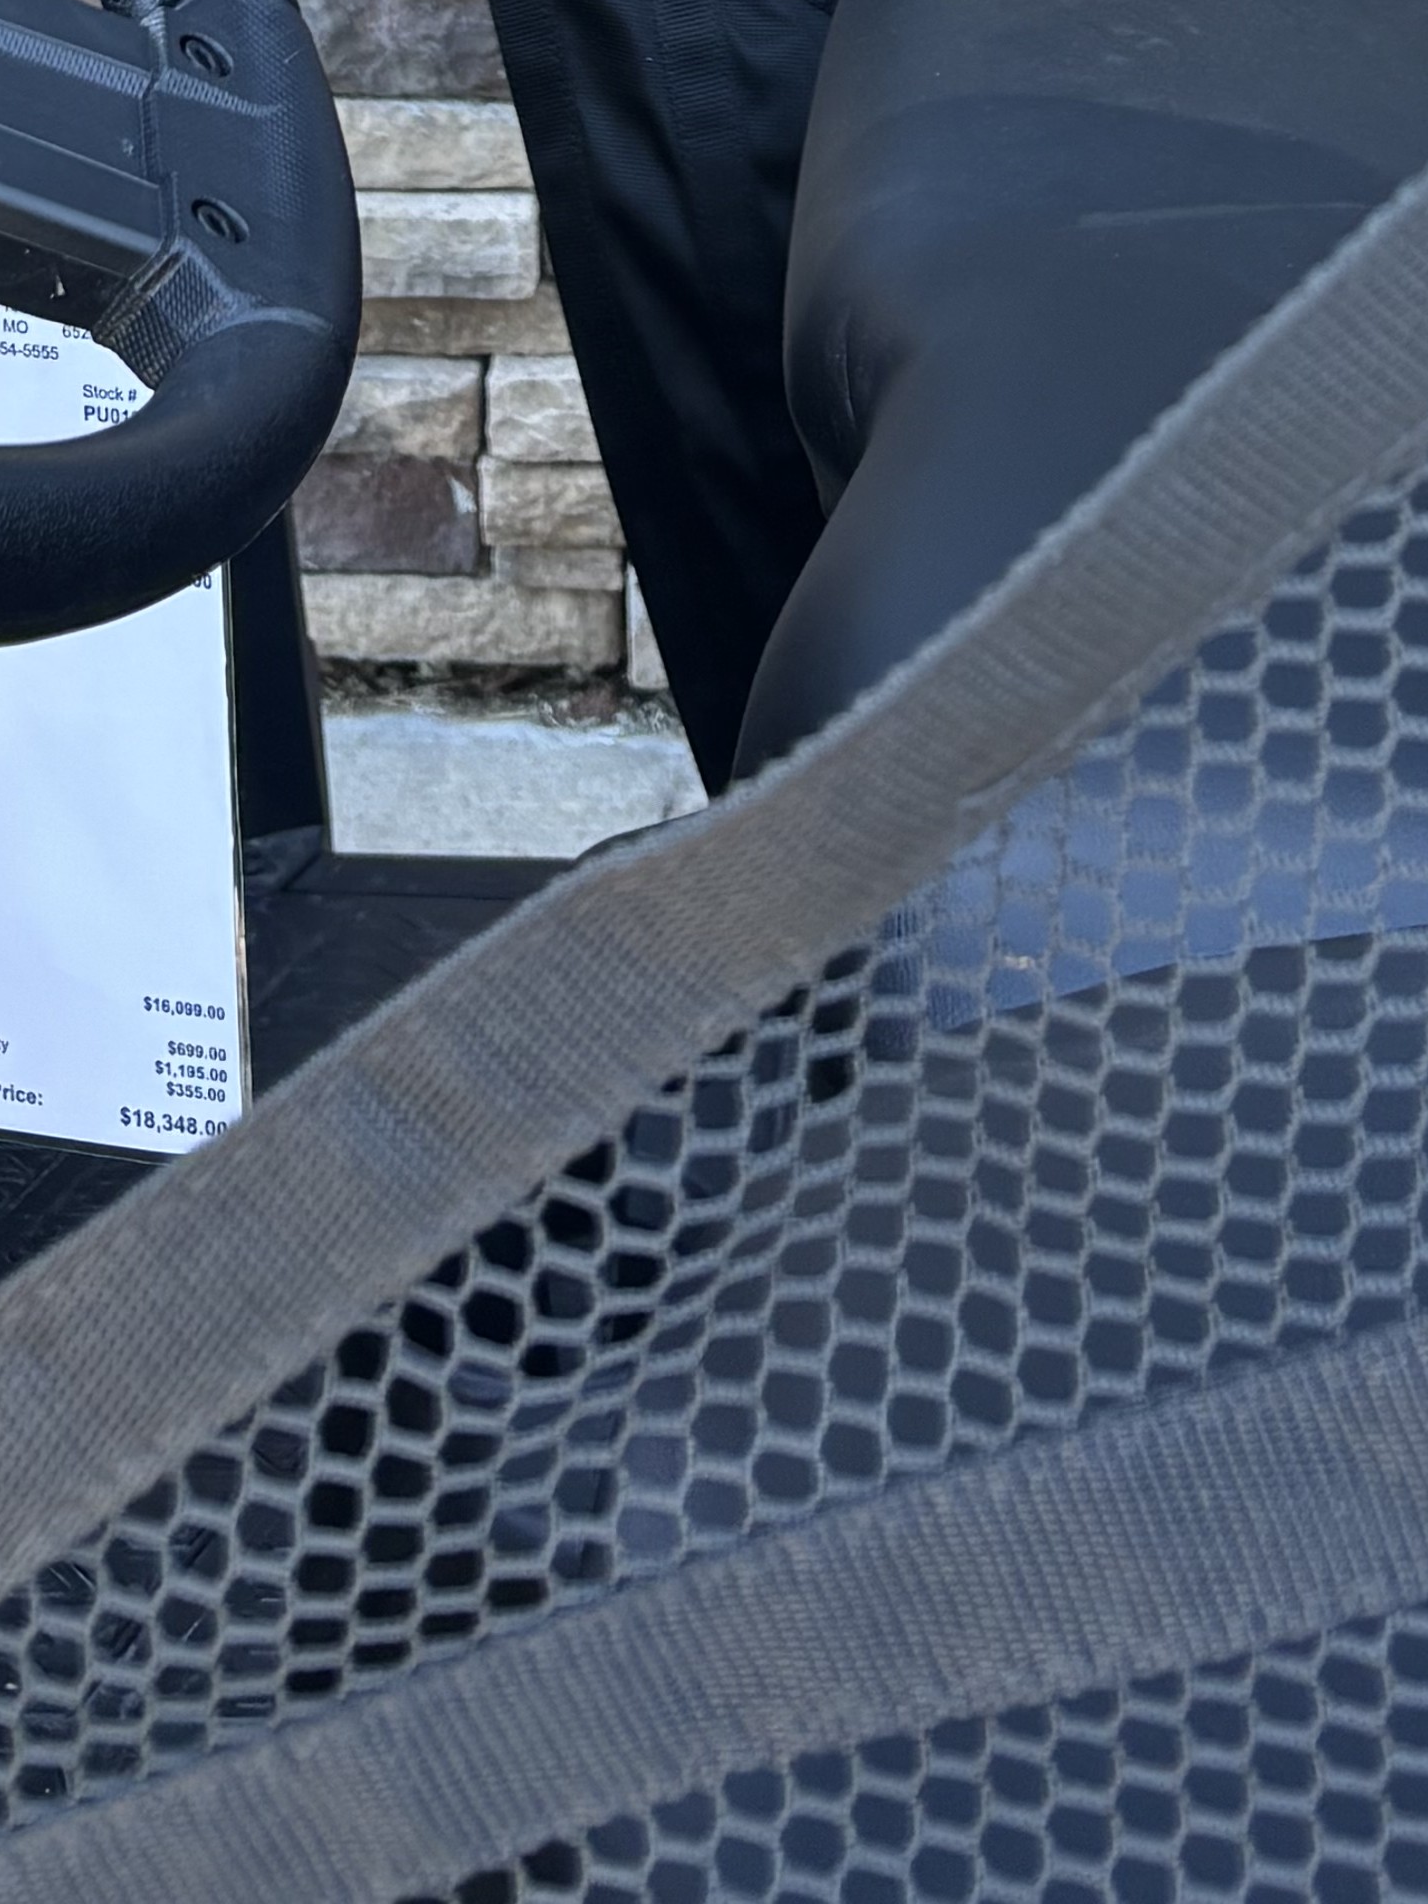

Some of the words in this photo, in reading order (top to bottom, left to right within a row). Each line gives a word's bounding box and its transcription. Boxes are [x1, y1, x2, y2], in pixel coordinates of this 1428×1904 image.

[3, 318, 29, 335] MO
[82, 384, 124, 402] Stock
[142, 995, 226, 1021] $16,099.00
[167, 1039, 227, 1062] $699.00
[154, 1059, 228, 1084] $1,195.00
[166, 1081, 226, 1103] $355.00
[119, 1106, 228, 1137] $18,348.00
